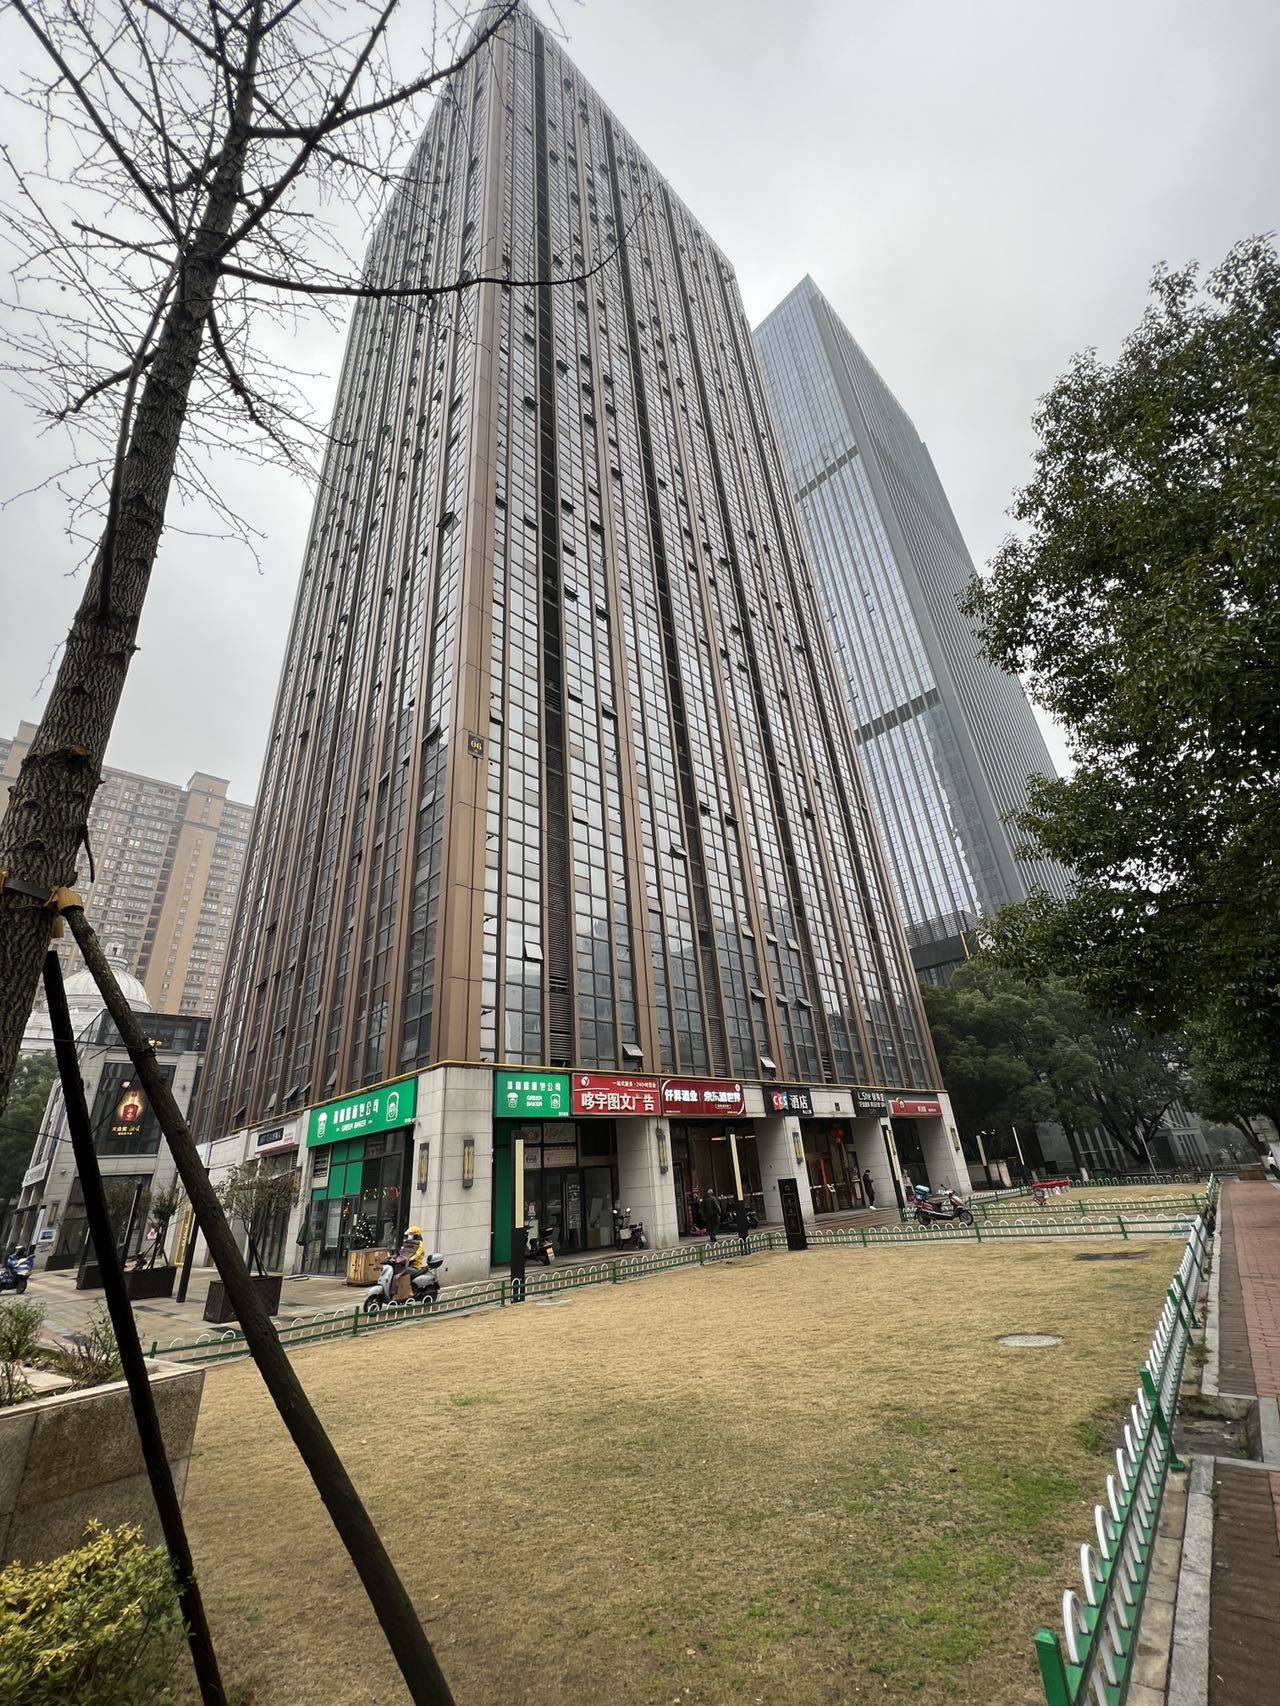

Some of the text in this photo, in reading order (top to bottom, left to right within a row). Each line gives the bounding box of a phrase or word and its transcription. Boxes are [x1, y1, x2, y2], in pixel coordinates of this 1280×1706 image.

[581, 1091, 655, 1111] 哆宇图文广告
